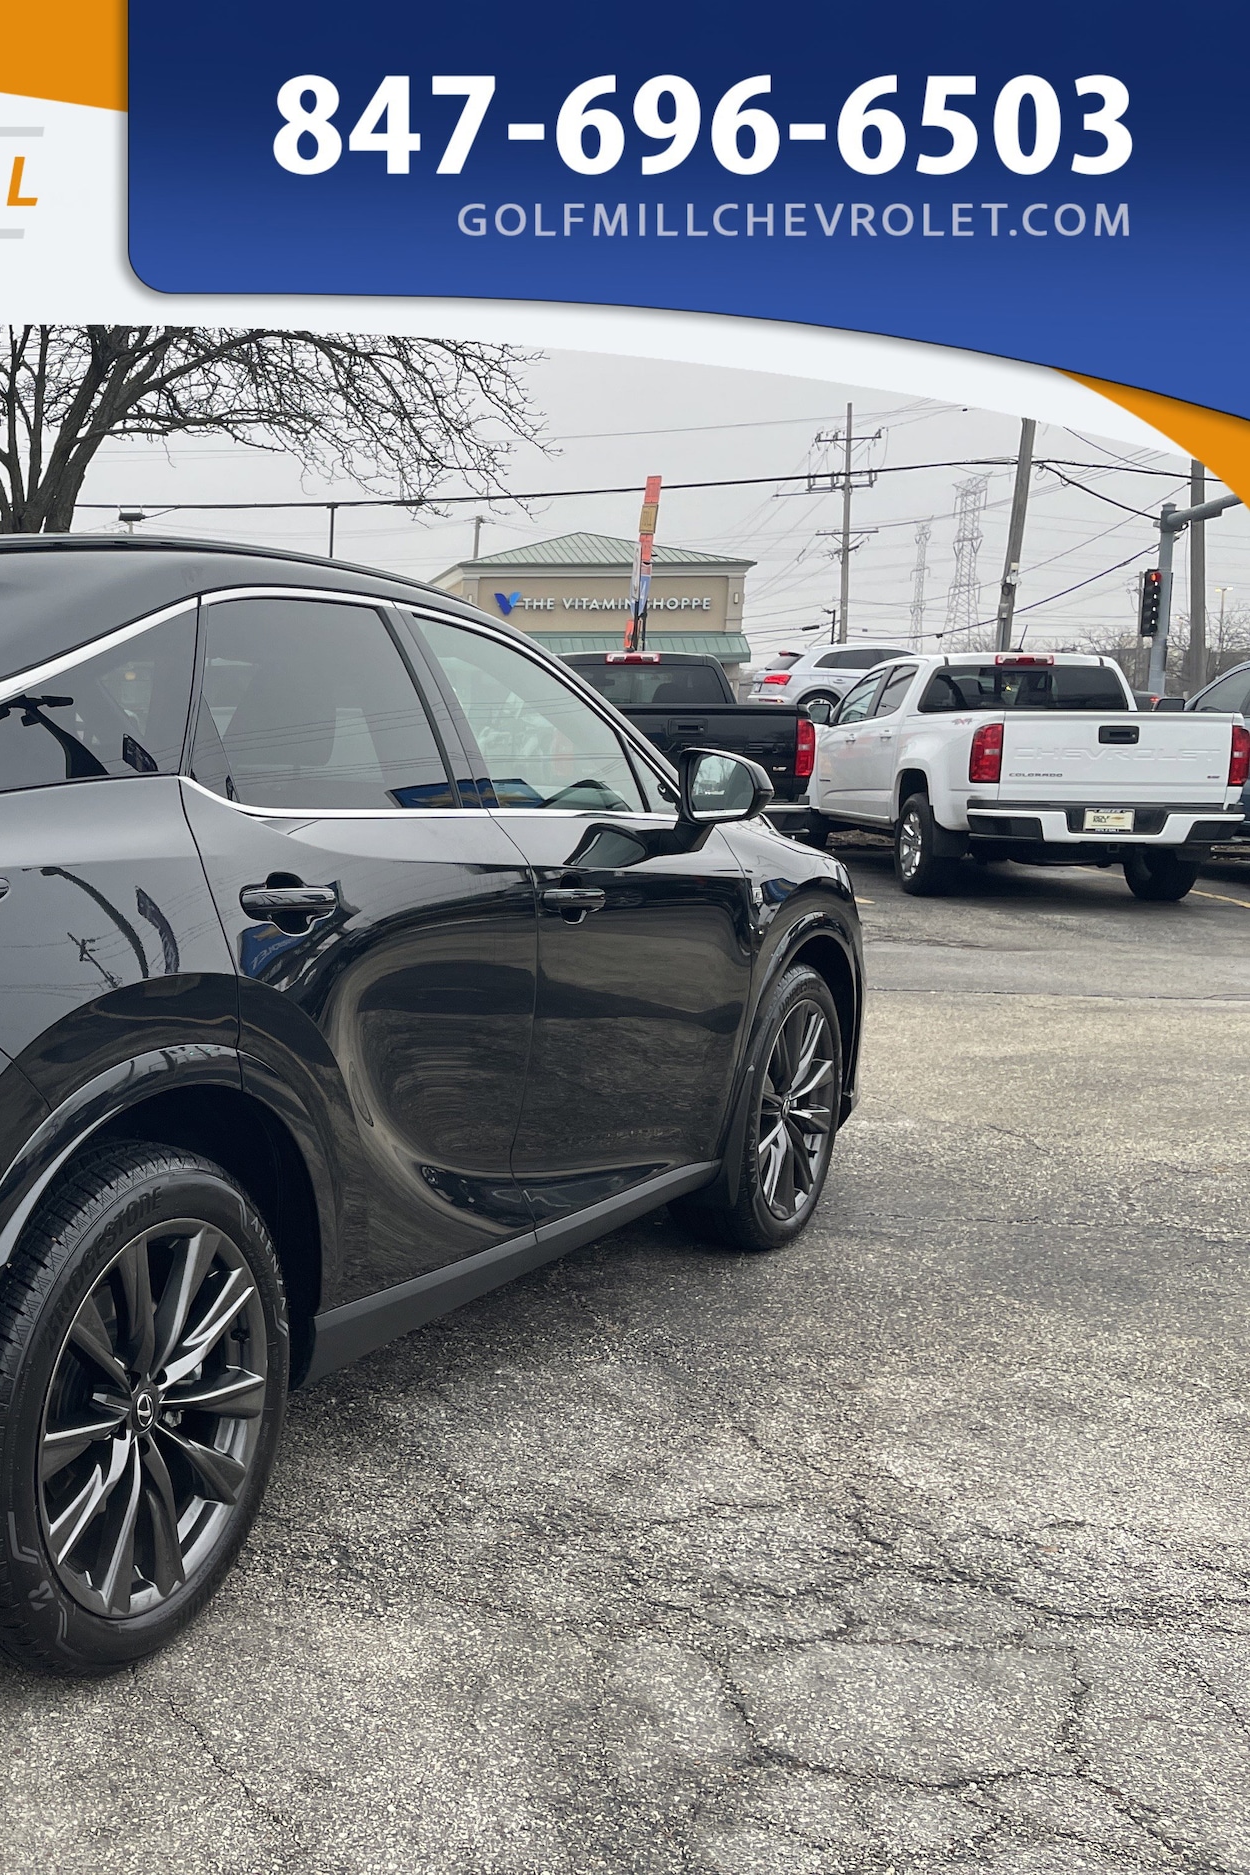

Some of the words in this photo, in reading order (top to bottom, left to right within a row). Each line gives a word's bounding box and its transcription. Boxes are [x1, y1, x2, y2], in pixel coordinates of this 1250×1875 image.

[523, 597, 555, 611] THE
[563, 597, 633, 611] VITAMIN
[1013, 747, 1222, 762] CHEVROLET
